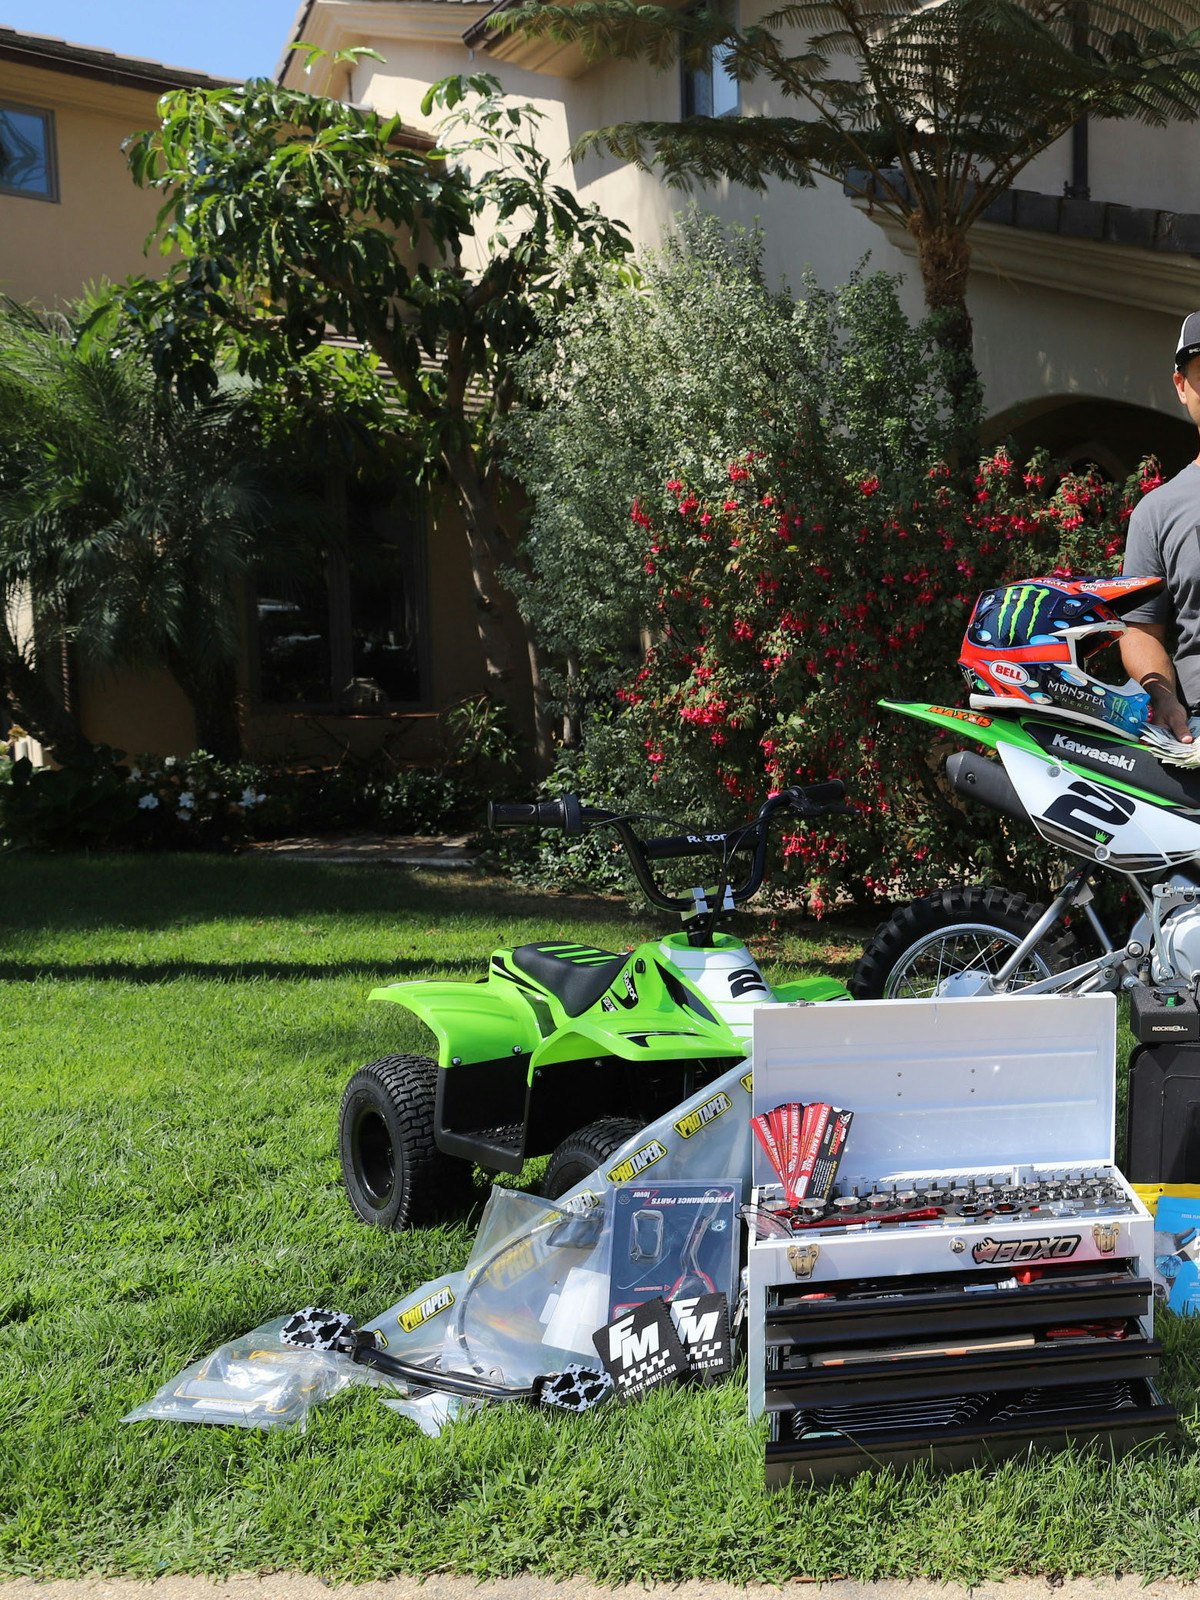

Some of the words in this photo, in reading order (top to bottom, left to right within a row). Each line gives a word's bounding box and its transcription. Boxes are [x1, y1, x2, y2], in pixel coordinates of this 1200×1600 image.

[994, 664, 1023, 682] BELL
[926, 706, 993, 727] MAXXIS
[1052, 733, 1136, 772] Kawasaki
[1042, 781, 1136, 846] 2
[728, 969, 767, 999] 2
[679, 1096, 729, 1137] PROTAPER
[814, 1106, 829, 1138] STANDARD
[809, 1138, 820, 1154] RACE
[677, 1195, 732, 1205] PERFORMANCE
[993, 1237, 1079, 1262] BOXO
[401, 1290, 450, 1331] PROTAPER
[609, 1314, 660, 1370] FM
